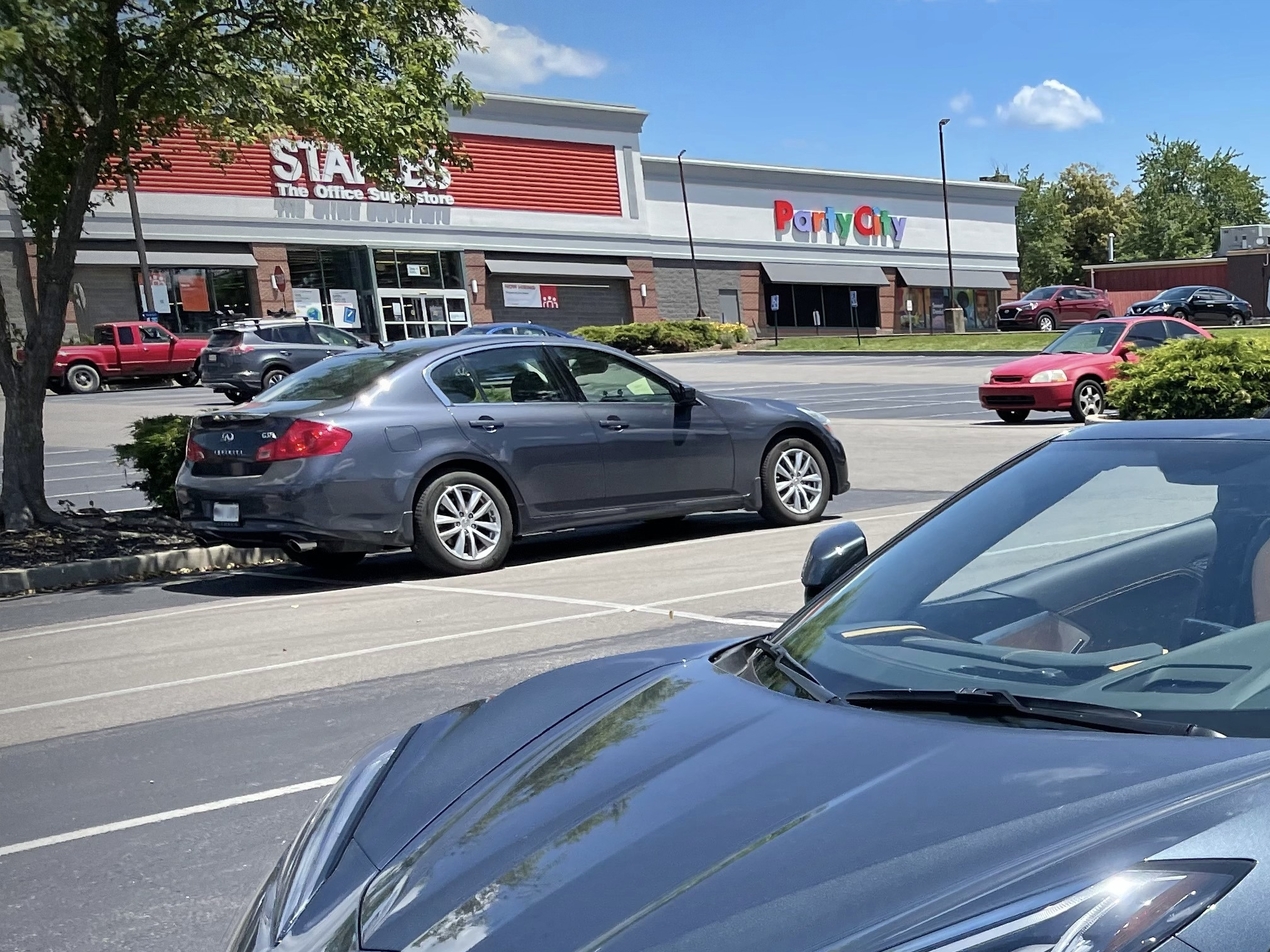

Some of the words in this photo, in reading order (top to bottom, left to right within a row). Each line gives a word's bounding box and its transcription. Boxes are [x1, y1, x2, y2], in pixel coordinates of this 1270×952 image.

[275, 182, 309, 198] The
[314, 183, 365, 200] Office
[774, 200, 853, 240] Party
[854, 205, 907, 241] City
